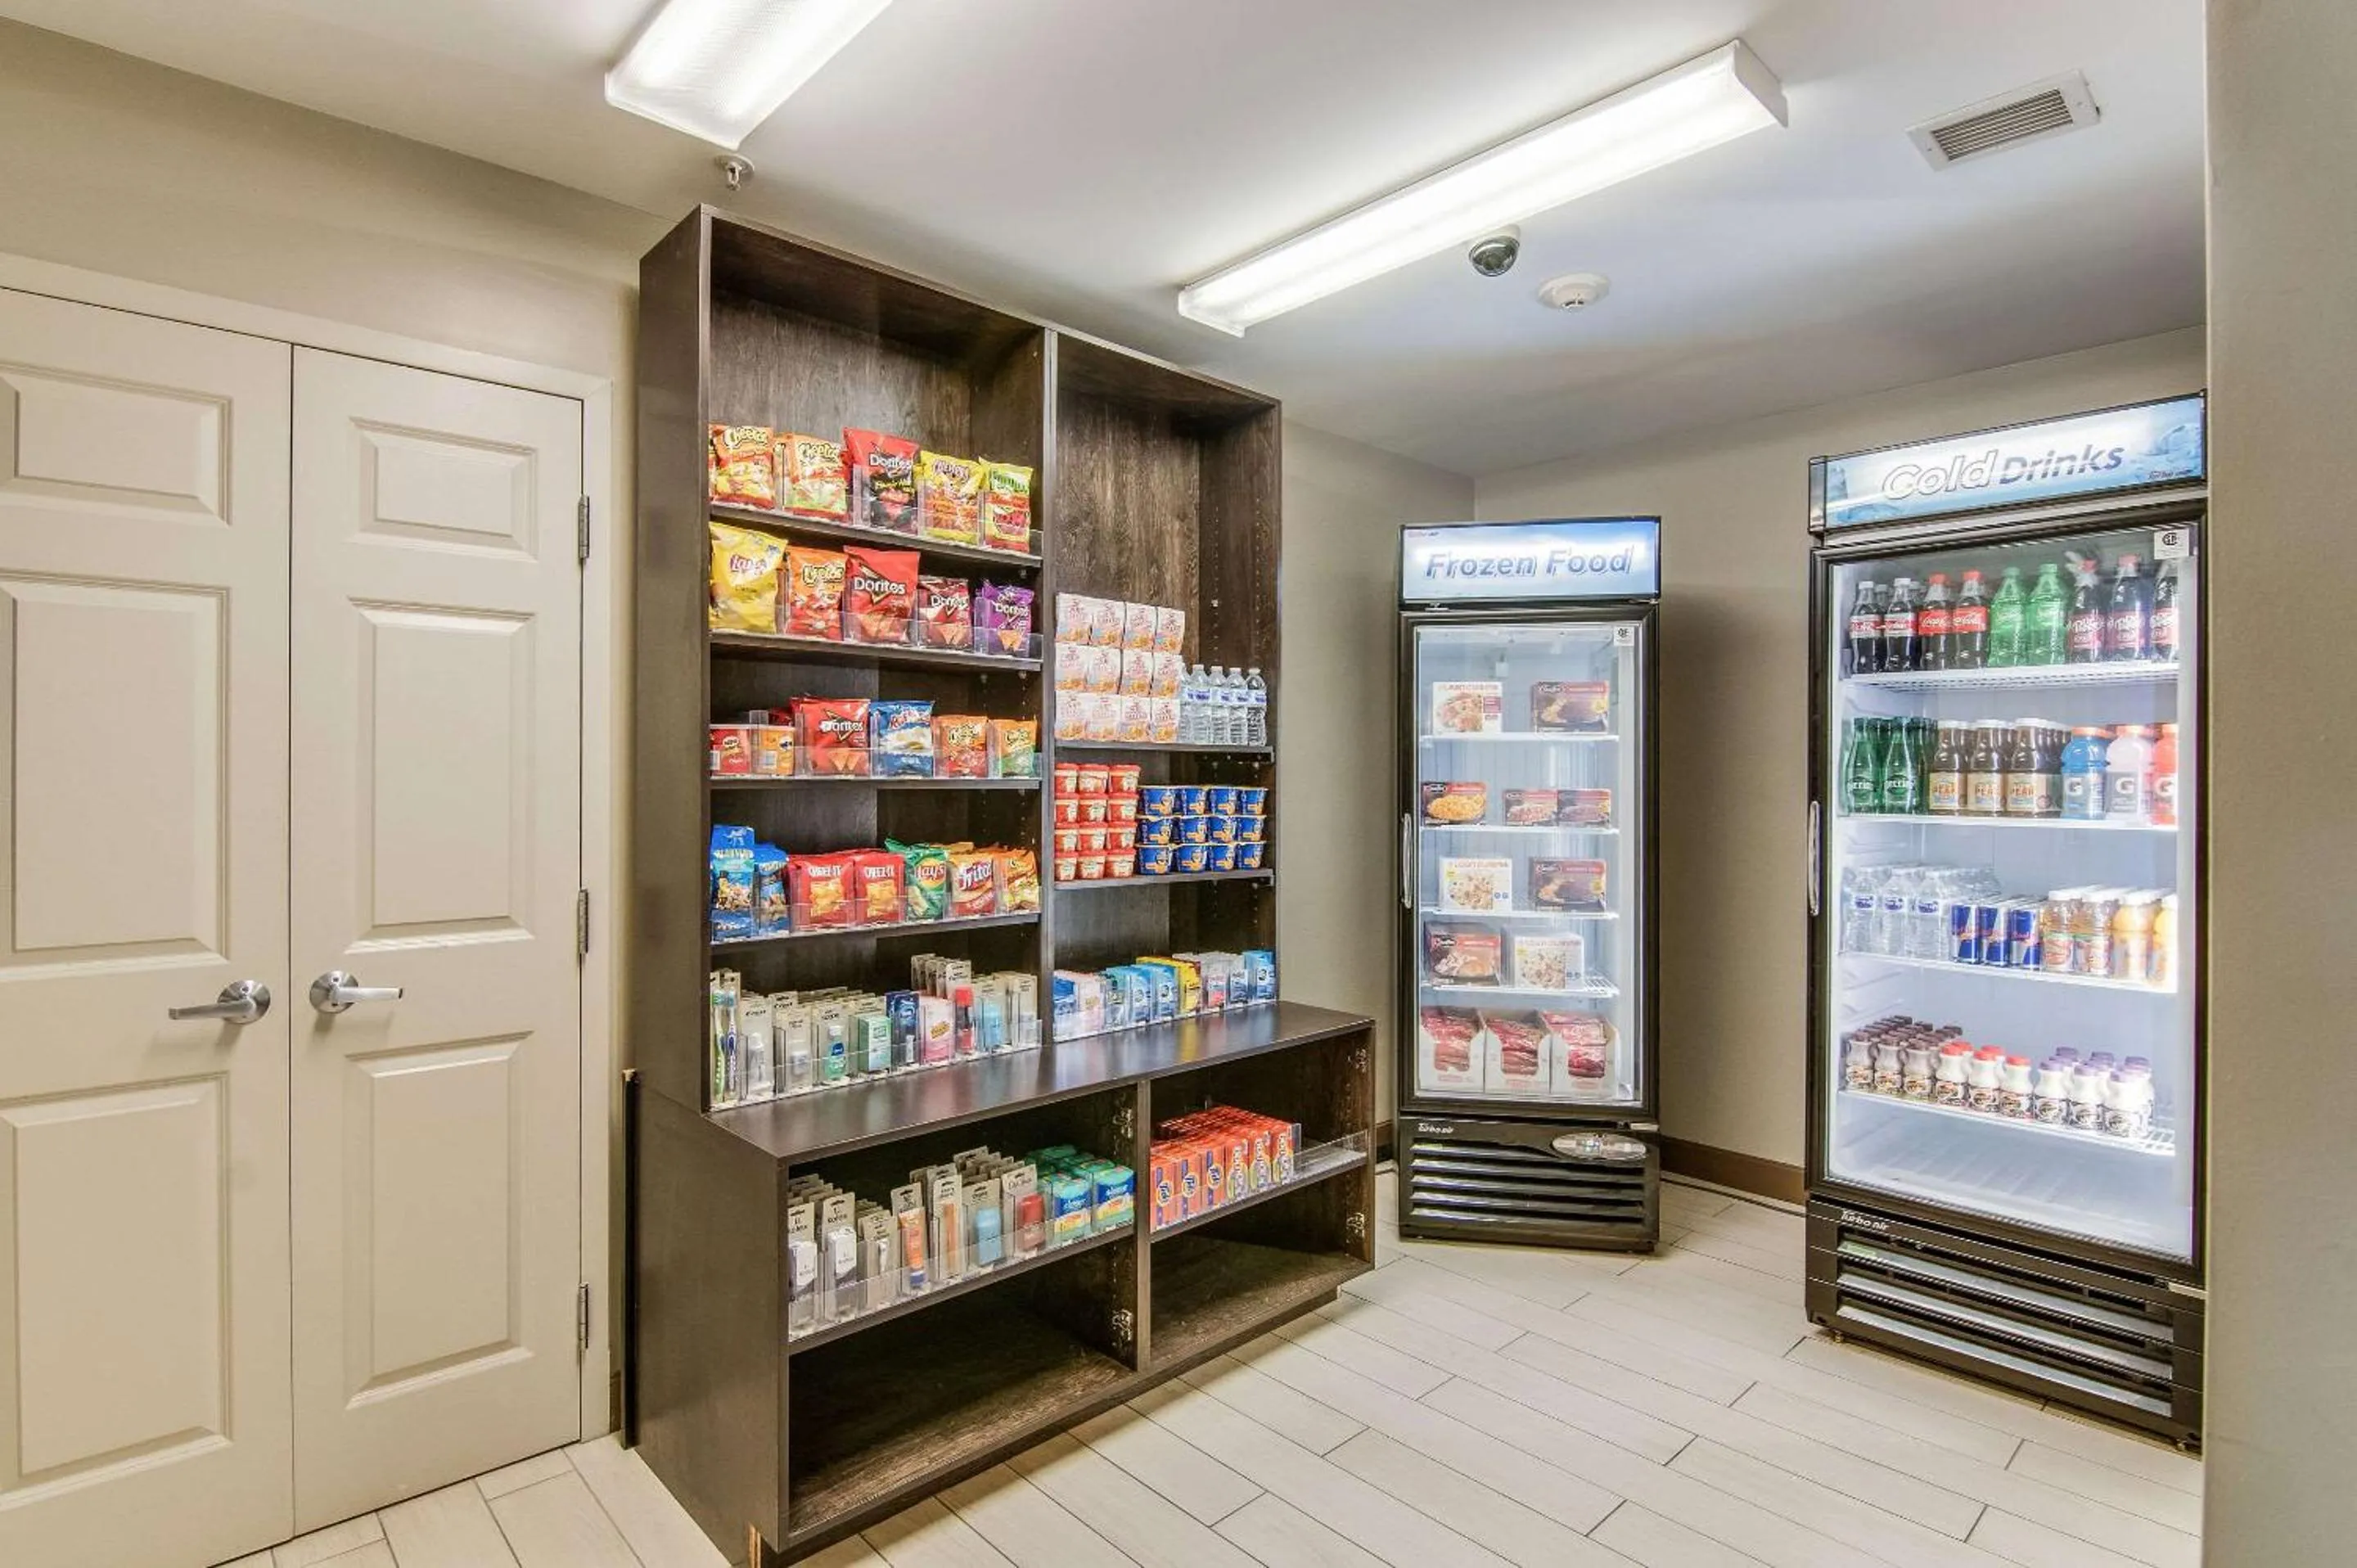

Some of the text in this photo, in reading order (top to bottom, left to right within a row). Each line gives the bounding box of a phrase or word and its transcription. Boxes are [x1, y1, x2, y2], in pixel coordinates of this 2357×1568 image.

[1882, 444, 2125, 500] Cold Drinks
[1426, 545, 1634, 579] Frozen Food
[854, 577, 906, 595] Doritos
[931, 594, 970, 611] Doritos
[820, 720, 863, 733] Doritos
[2066, 777, 2084, 796] G
[2116, 777, 2134, 794] G
